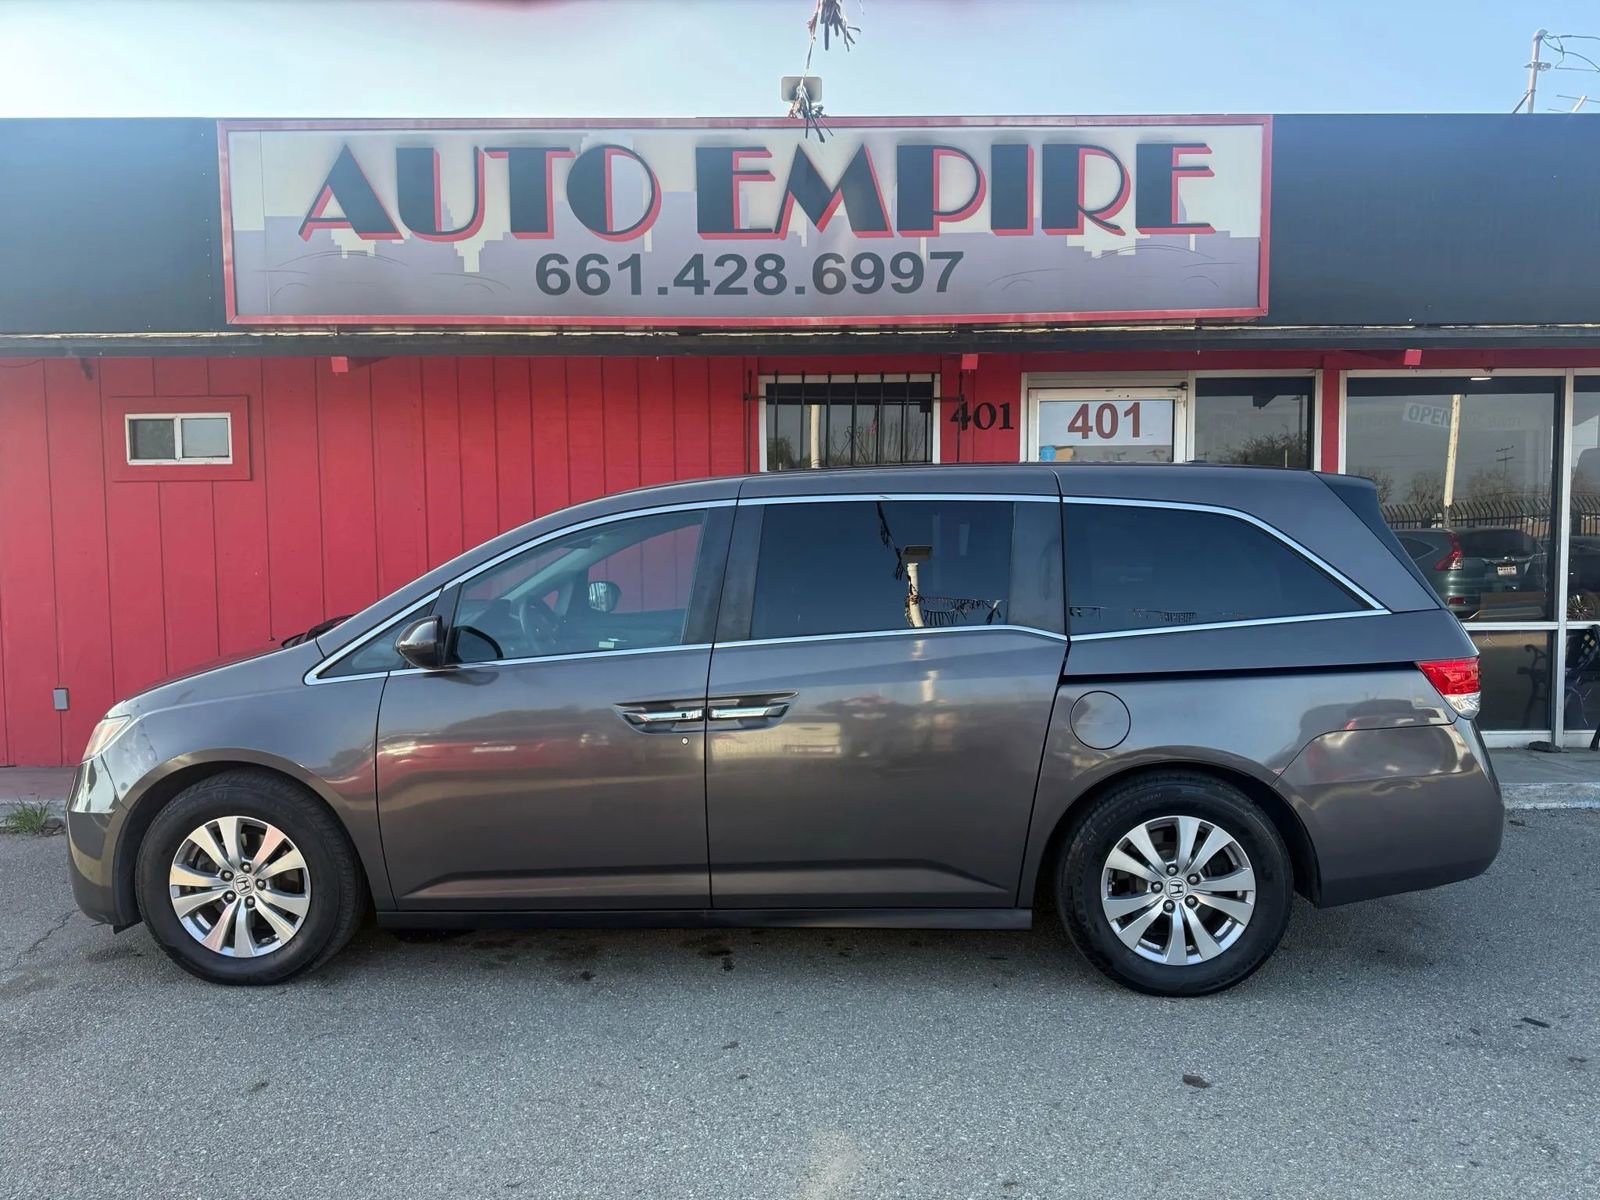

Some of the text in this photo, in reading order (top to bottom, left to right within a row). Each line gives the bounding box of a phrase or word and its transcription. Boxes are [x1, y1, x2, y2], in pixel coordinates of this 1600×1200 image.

[298, 143, 1217, 242] AUTO EMPIRE
[535, 252, 964, 296] 661.428.6997
[950, 402, 1014, 430] 401
[1067, 401, 1141, 440] 401
